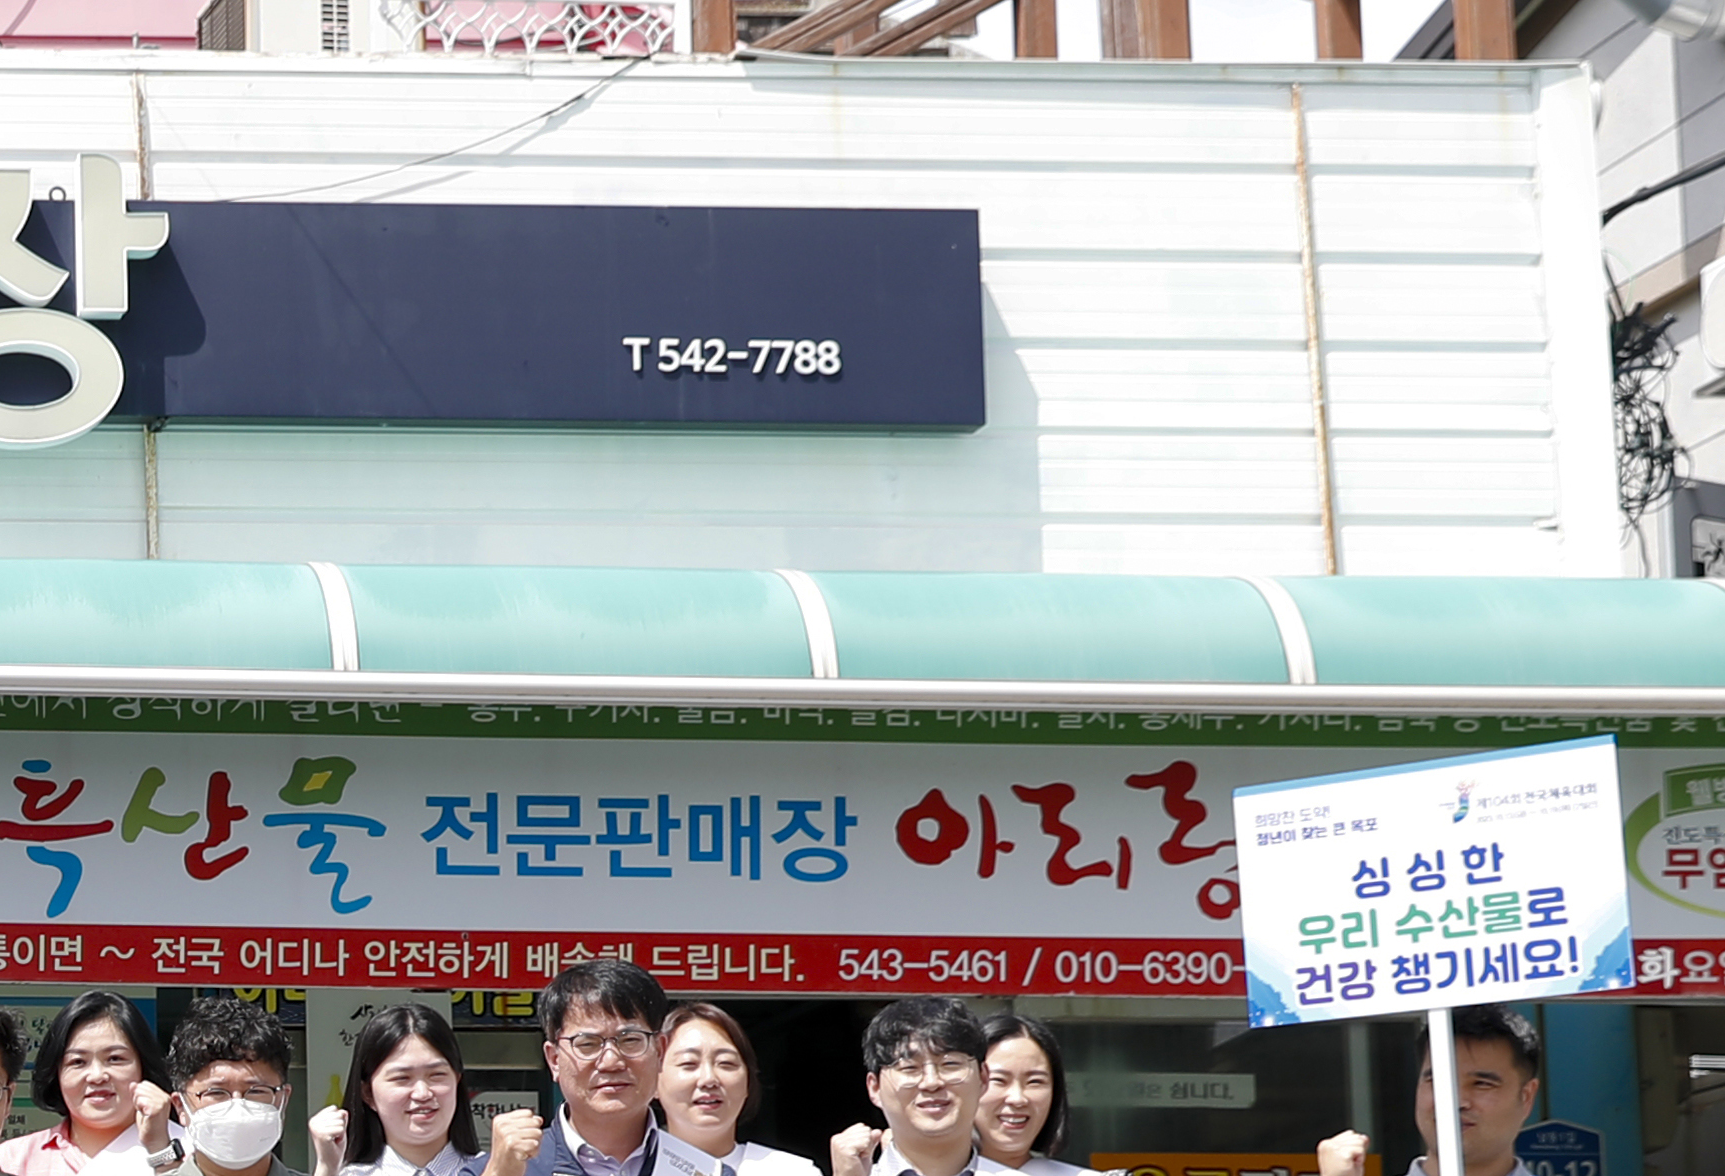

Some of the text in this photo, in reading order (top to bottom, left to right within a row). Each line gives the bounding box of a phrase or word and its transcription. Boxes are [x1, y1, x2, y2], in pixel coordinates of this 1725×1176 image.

[622, 338, 842, 376] T 542-7788
[421, 791, 858, 883] 전문판매장
[1297, 886, 1569, 955] 우리 수산물로
[151, 935, 225, 975] 전국
[238, 935, 348, 979] 어디나
[364, 936, 512, 981] 안전하게
[647, 943, 807, 983] 드립니다.
[839, 949, 1009, 983] 543-5461
[1294, 936, 1579, 1007] 건강 챙기세요!
